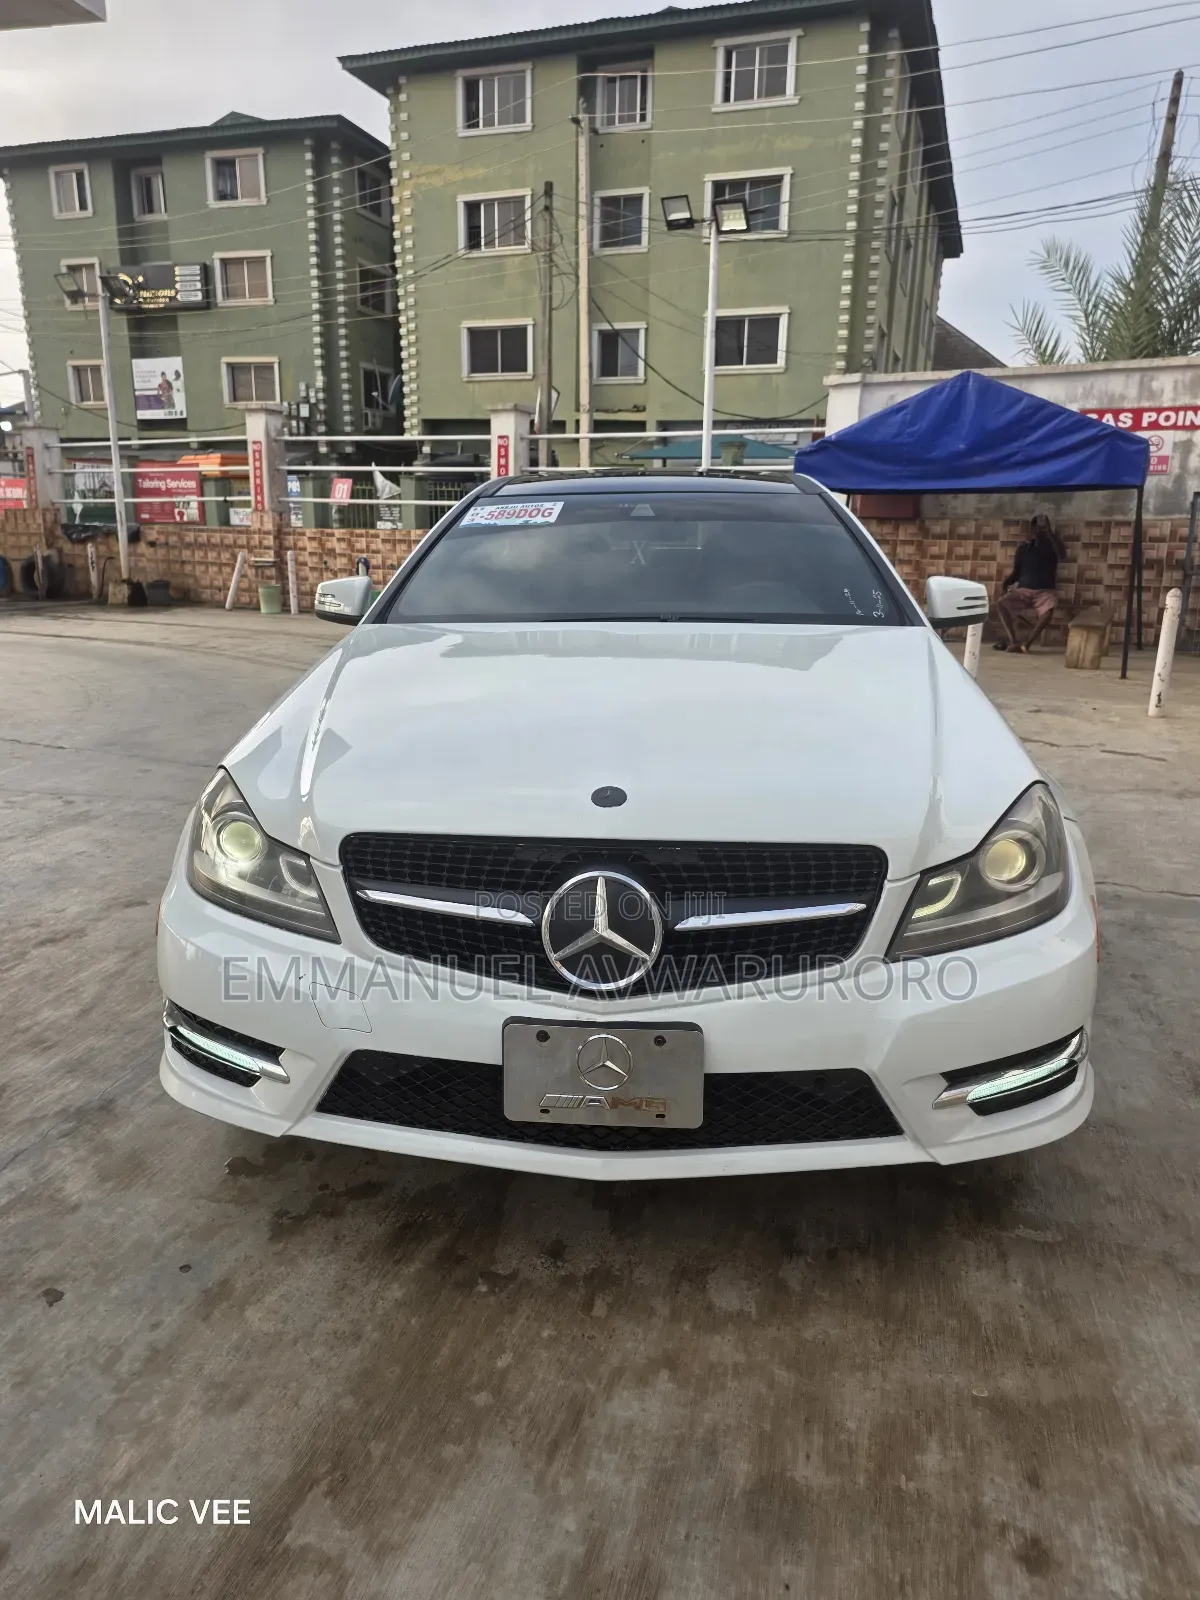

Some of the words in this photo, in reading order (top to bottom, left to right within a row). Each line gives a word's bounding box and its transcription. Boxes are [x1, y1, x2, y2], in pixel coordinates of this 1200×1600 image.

[1141, 410, 1200, 427] POIN
[138, 479, 166, 491] Tailoring
[166, 478, 196, 489] Services
[335, 483, 348, 499] 01
